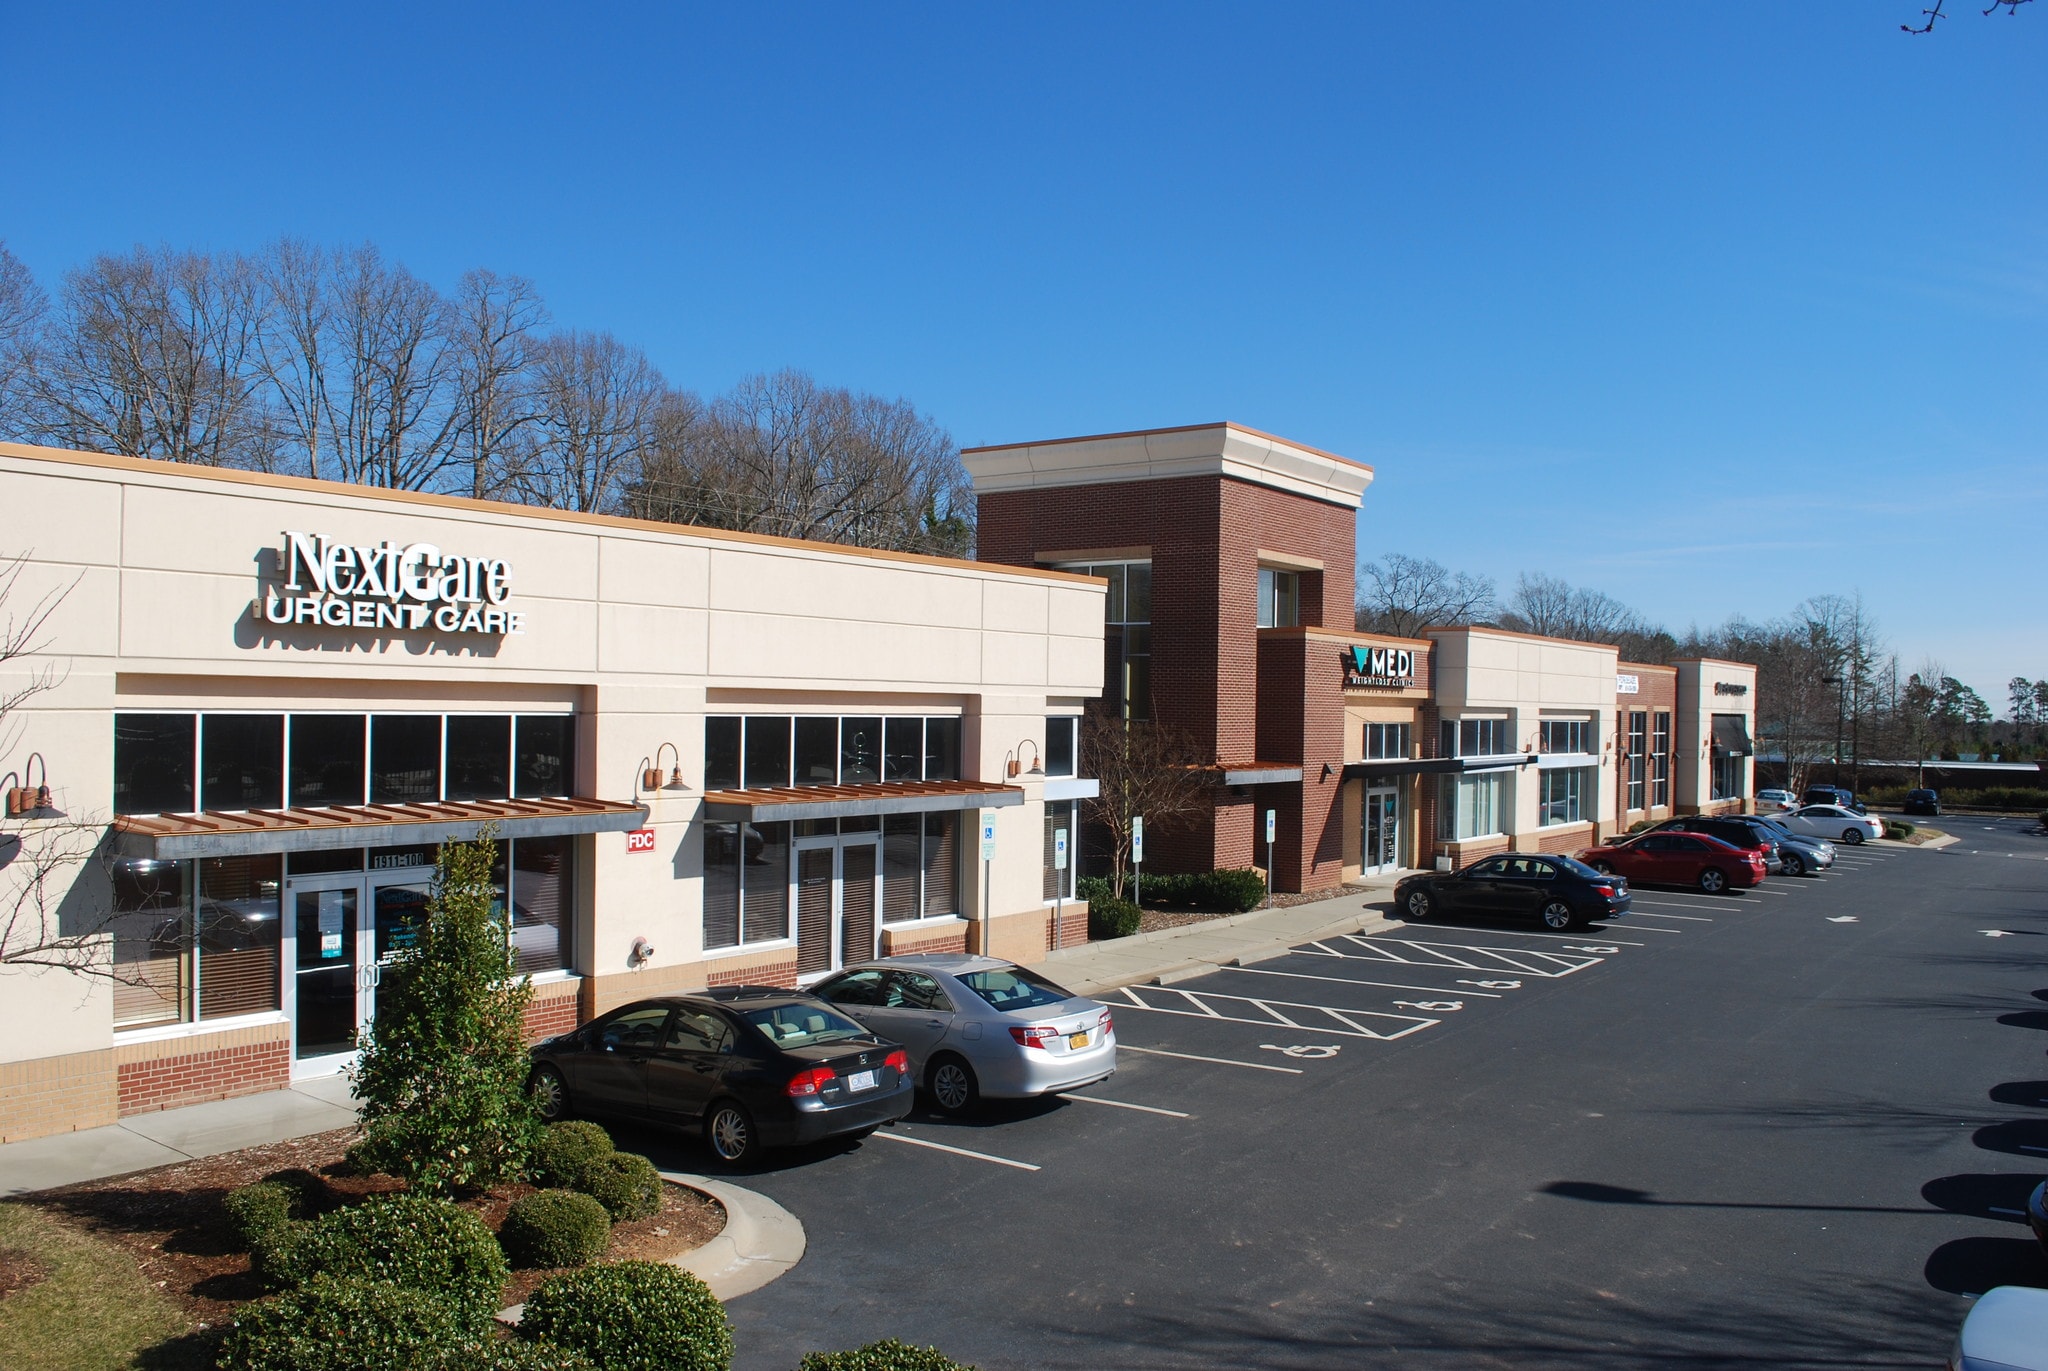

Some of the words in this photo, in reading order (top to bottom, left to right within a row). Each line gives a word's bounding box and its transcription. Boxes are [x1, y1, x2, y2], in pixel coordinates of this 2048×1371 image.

[281, 530, 513, 606] NextCare
[265, 596, 426, 630] URGENT
[434, 607, 528, 635] CARE
[1372, 648, 1415, 677] MEDI
[629, 832, 653, 849] FDC
[375, 853, 423, 868] 1911-100
